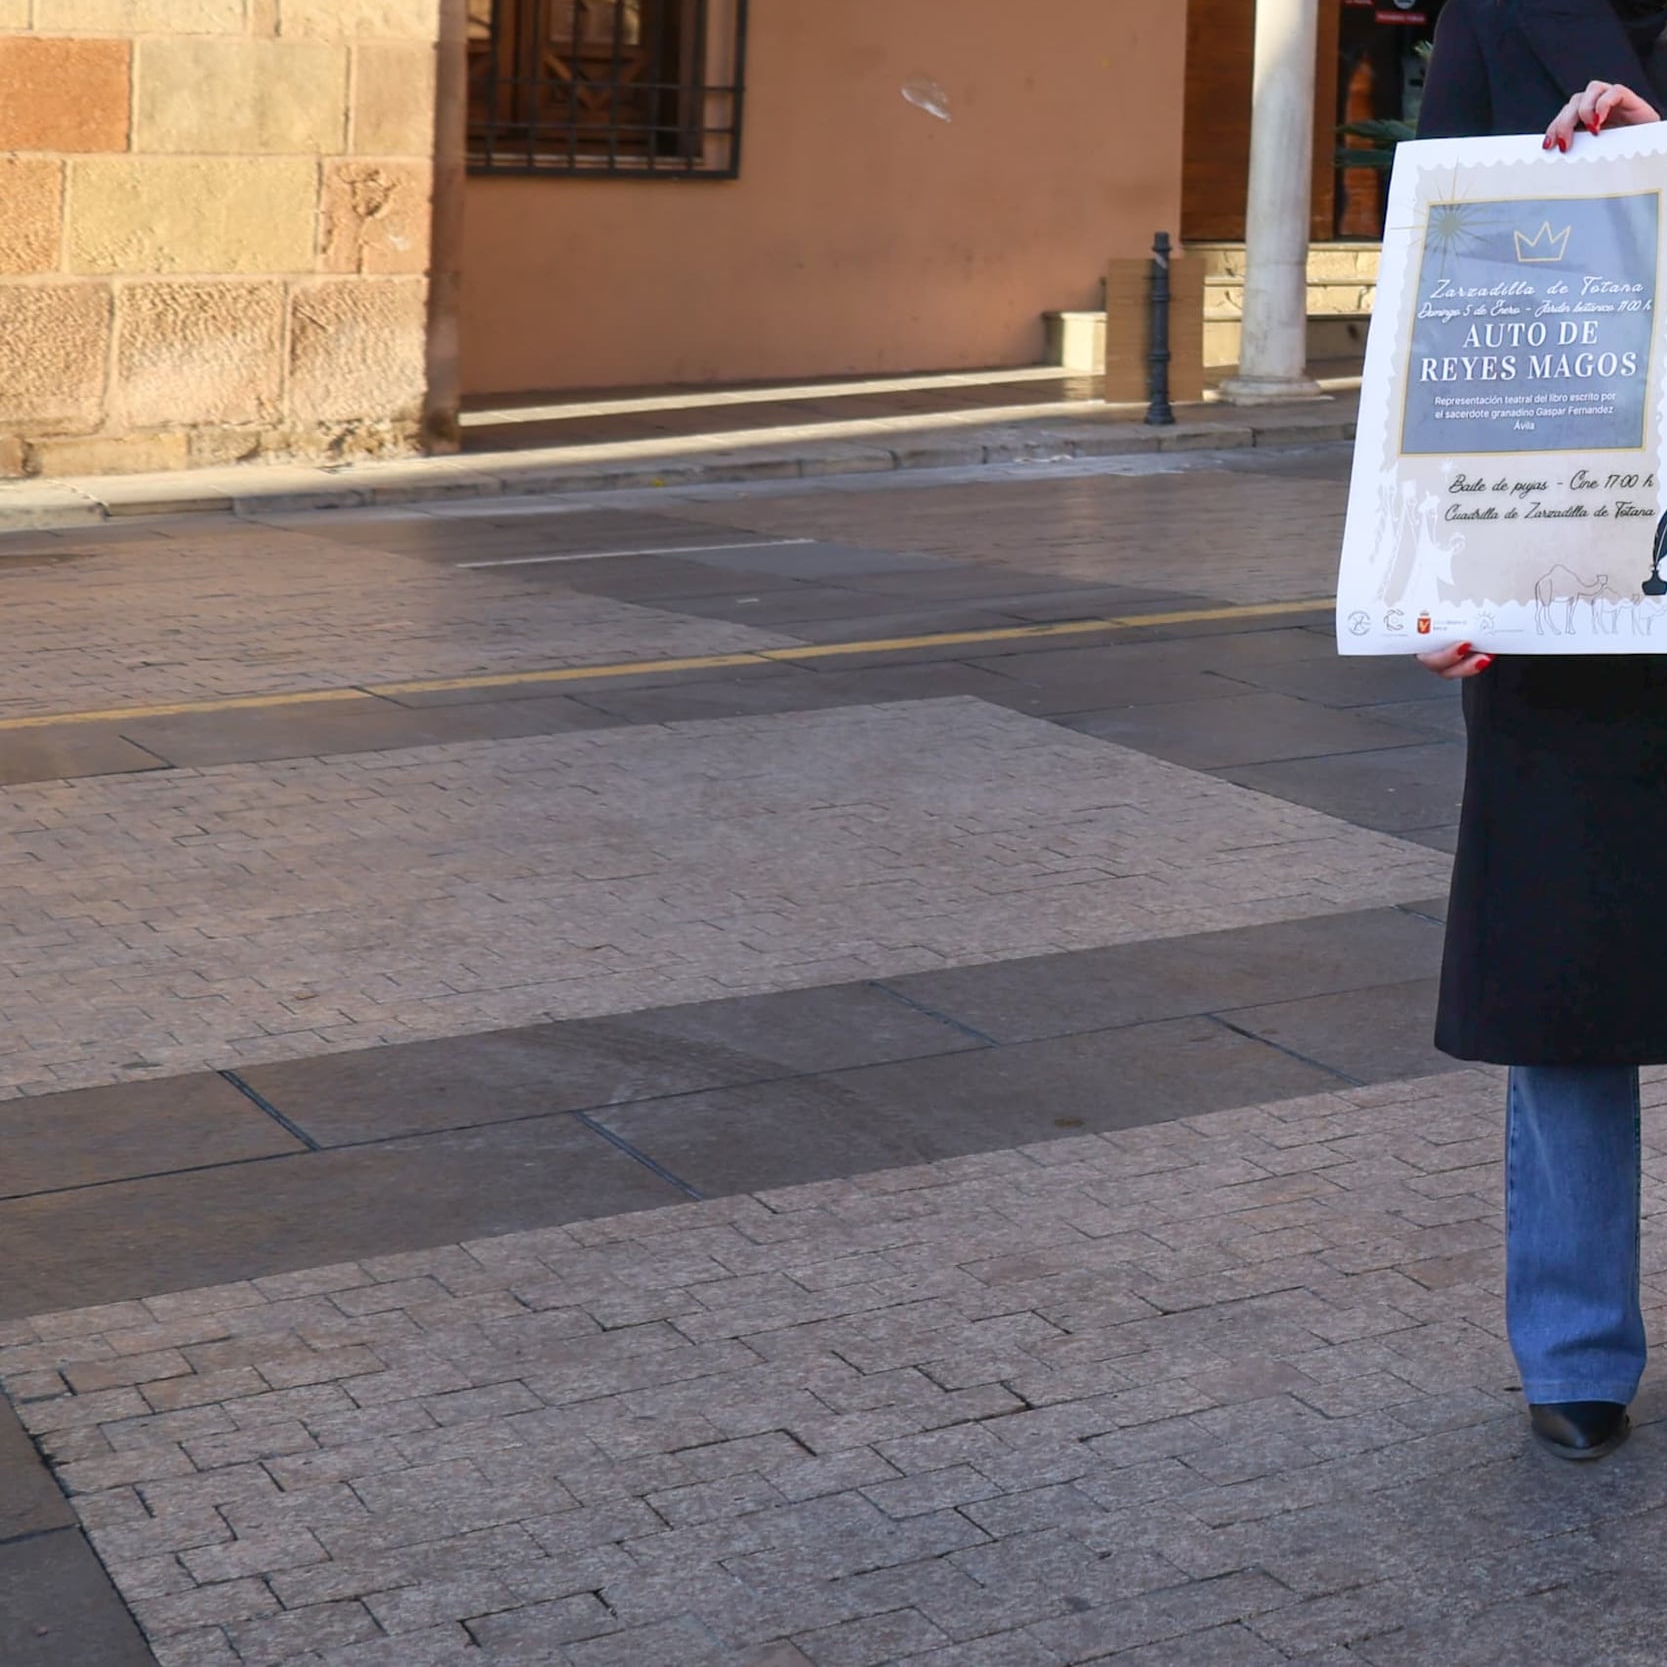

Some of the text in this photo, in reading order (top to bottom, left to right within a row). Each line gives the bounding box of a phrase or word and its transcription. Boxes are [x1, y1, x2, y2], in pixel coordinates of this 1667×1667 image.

[1430, 276, 1643, 299] Zarzadilla de Totana
[1463, 304, 1472, 316] 5
[1474, 305, 1487, 315] de
[1643, 299, 1652, 310] h
[1463, 320, 1598, 348] AUTO DE
[1420, 352, 1637, 382] REYES MAGOS
[1435, 392, 1616, 406] Representación teatral del libro escrito por
[1435, 405, 1613, 419] el sacerdote granadino Gaspar Fernandez
[1448, 474, 1486, 494] Baile
[1492, 478, 1508, 491] de
[1510, 480, 1548, 499] pujas
[1570, 470, 1598, 490] Cine
[1642, 473, 1654, 488] h
[1444, 501, 1655, 521] Cuadrilla de Zarzadilla de Totana
